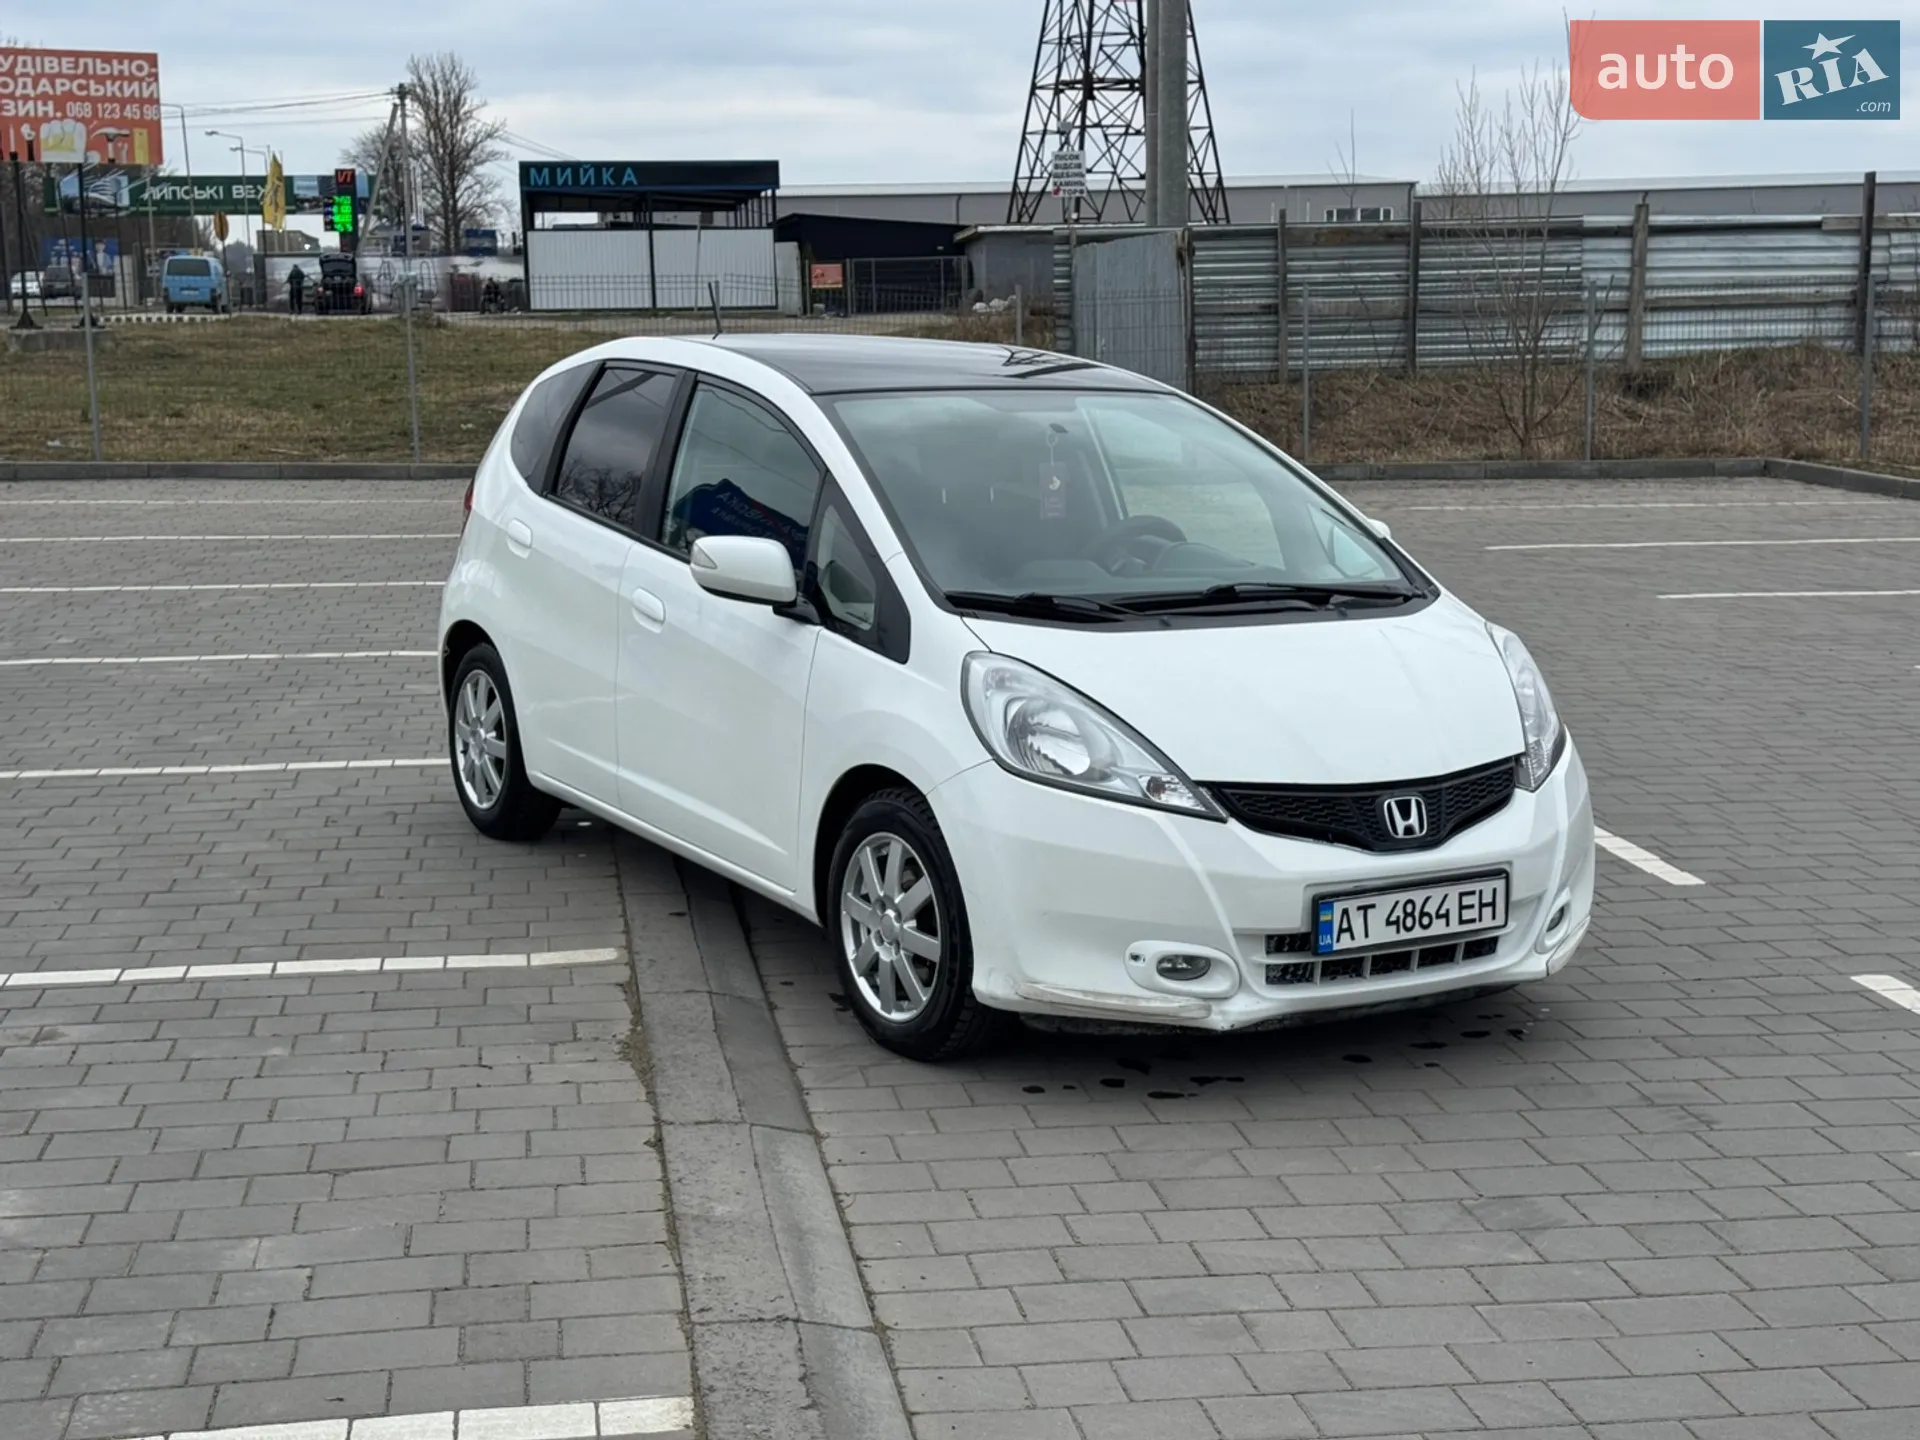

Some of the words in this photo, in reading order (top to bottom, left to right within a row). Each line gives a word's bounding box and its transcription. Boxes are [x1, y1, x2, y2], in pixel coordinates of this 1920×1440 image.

[0, 76, 158, 99] ОДАРСЬКИЙ
[1, 99, 62, 118] ЗИН.
[66, 101, 92, 119] 068
[97, 102, 121, 119] 123
[123, 103, 141, 120] 45
[529, 163, 638, 187] МИЙКА
[1336, 902, 1377, 944] AT
[1385, 893, 1451, 936] 4864
[1457, 886, 1498, 926] EH
[1318, 934, 1333, 946] UA
